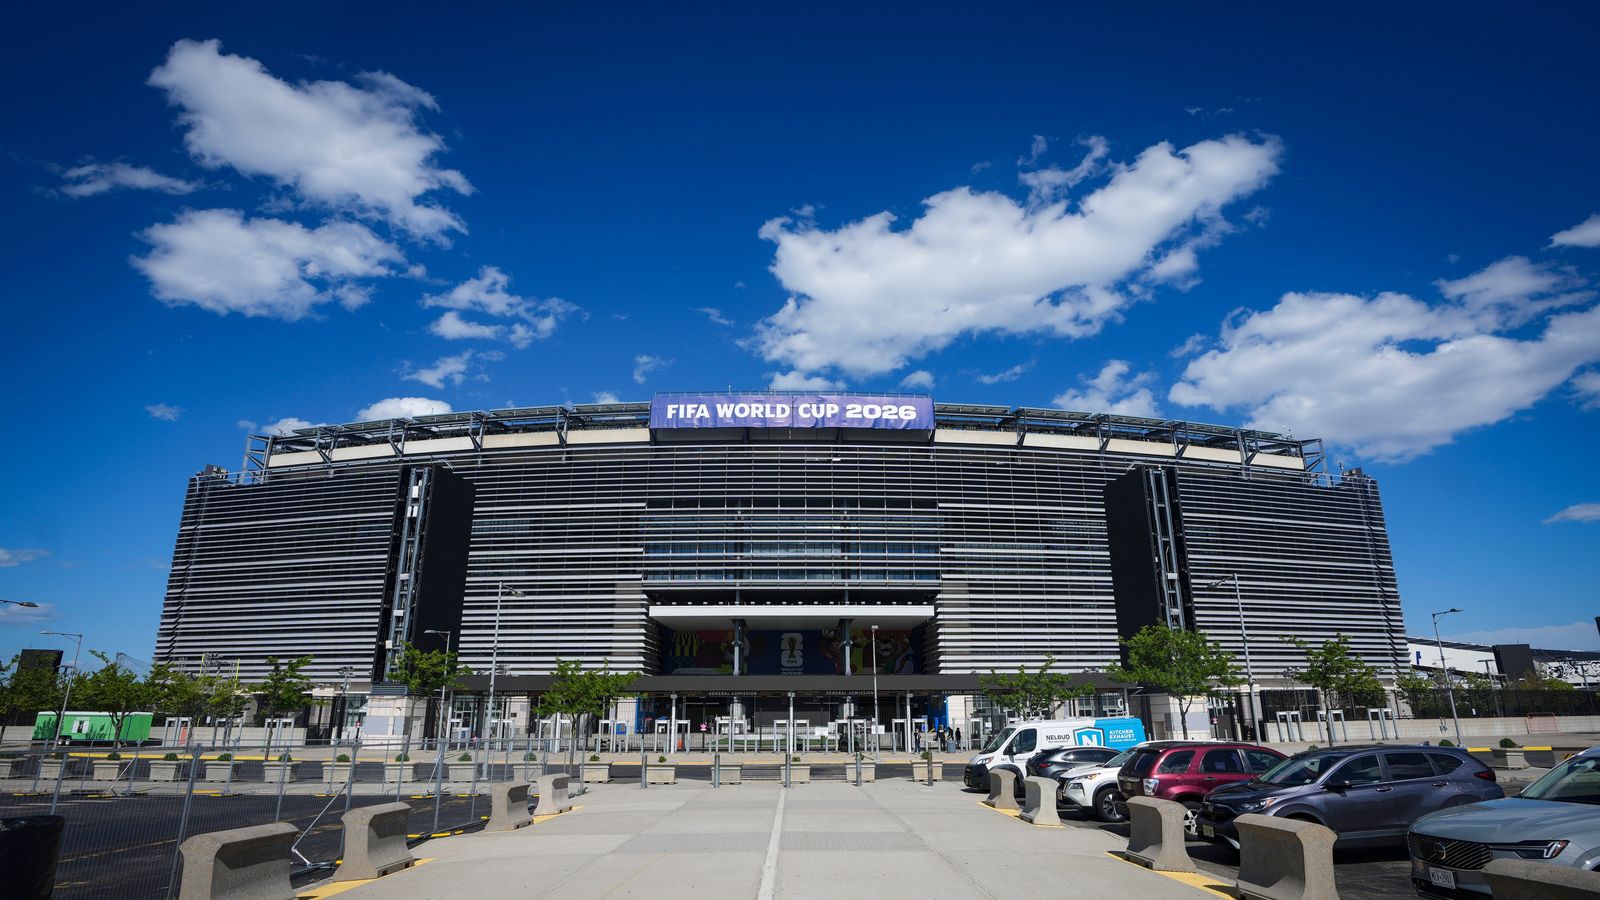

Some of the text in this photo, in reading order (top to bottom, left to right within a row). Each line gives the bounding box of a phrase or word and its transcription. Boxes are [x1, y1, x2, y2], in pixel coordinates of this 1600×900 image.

[667, 403, 917, 420] FIFA WORLD CUP 2026
